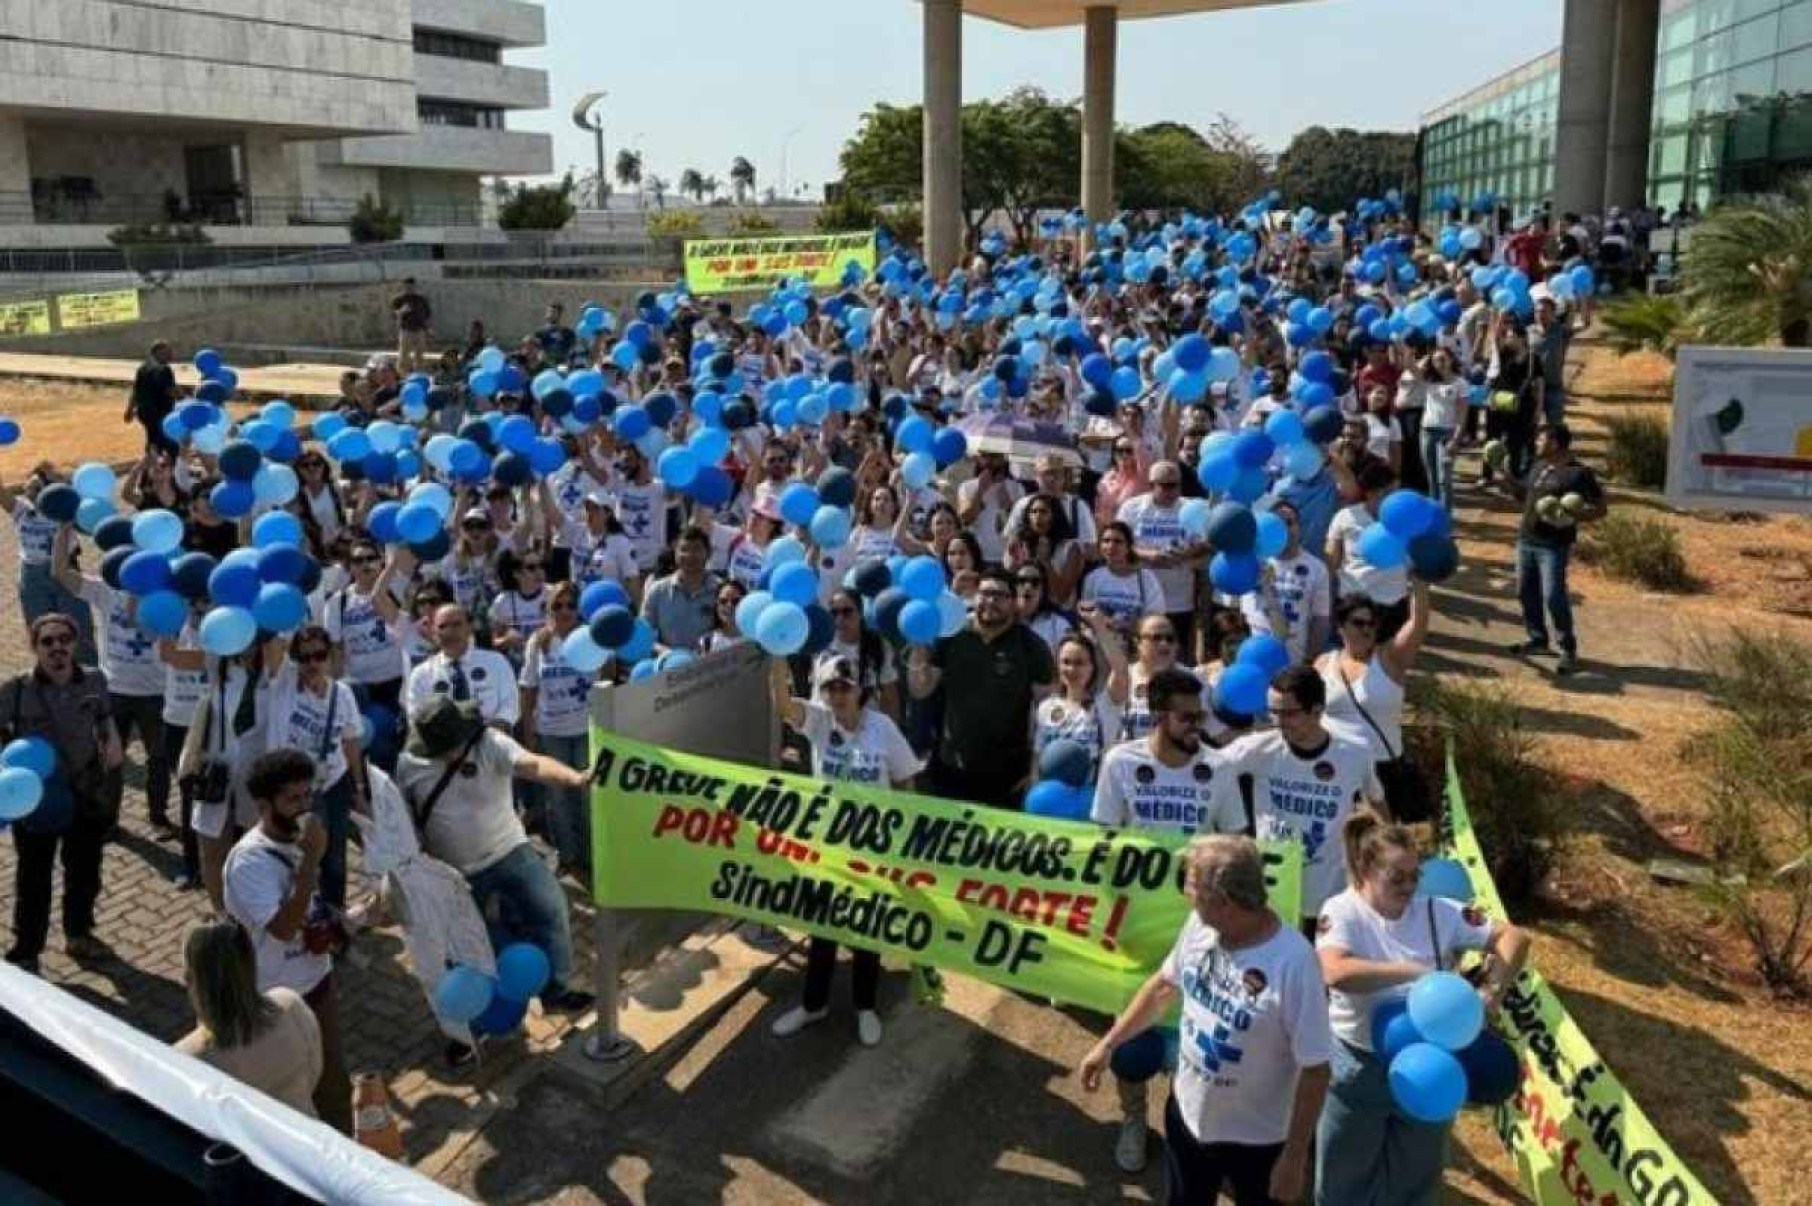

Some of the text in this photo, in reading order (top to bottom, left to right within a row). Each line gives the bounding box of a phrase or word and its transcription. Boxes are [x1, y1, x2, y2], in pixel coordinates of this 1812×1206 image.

[593, 748, 616, 788] A
[724, 776, 802, 833] NÃO
[795, 785, 834, 840] É
[823, 799, 904, 854] DOS
[902, 808, 1076, 881] MÉDICOS.
[1081, 831, 1117, 885] É
[1110, 845, 1172, 890] DO
[652, 803, 740, 849] POR
[710, 859, 933, 951] SindMédico
[973, 918, 1049, 975] DF
